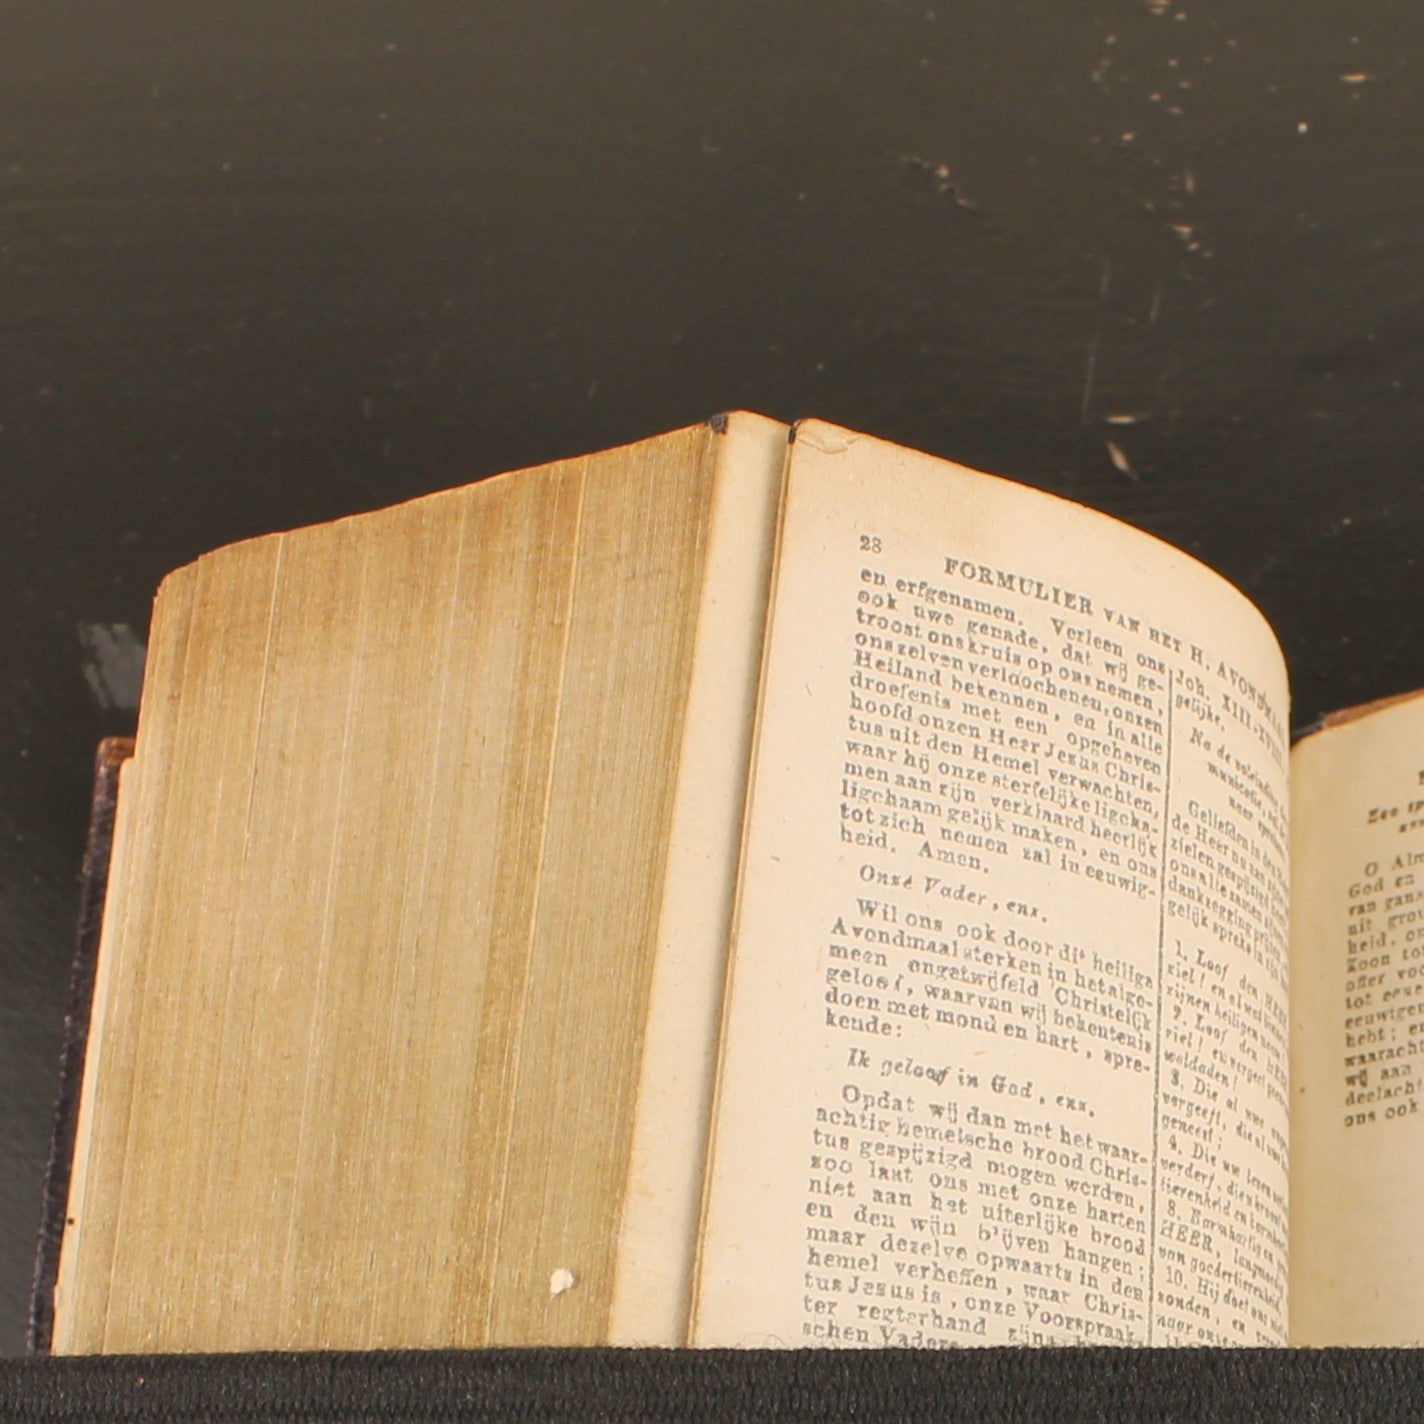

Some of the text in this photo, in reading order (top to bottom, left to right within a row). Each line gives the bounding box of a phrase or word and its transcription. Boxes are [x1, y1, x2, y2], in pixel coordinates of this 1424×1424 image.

[859, 534, 883, 554] 28
[856, 590, 1164, 691] ook uwe genade, dat wij ge-
[859, 568, 1165, 672] en erfgenamen. Verleen ons
[943, 556, 1094, 616] FORMULIER
[1190, 644, 1211, 671] H.
[848, 670, 1161, 774] droefenis met een opgeheven
[839, 822, 989, 871] heid. Amen.
[1363, 861, 1379, 877] O
[1347, 877, 1384, 898] God
[1393, 873, 1415, 887] en
[857, 898, 897, 922] Wil
[904, 912, 943, 931] ons
[956, 922, 996, 942] ook
[1002, 929, 1053, 955] door
[956, 1067, 979, 1088] in
[1342, 1110, 1376, 1126] ons
[1384, 1097, 1418, 1118] ook
[808, 1176, 856, 1196] niet
[871, 1188, 912, 1204] aan
[929, 1191, 968, 1213] het
[1089, 1225, 1147, 1253] brood
[928, 1173, 968, 1191] ons
[977, 1182, 1020, 1201] met
[1028, 1192, 1077, 1214] onze
[1086, 1200, 1148, 1232] harten
